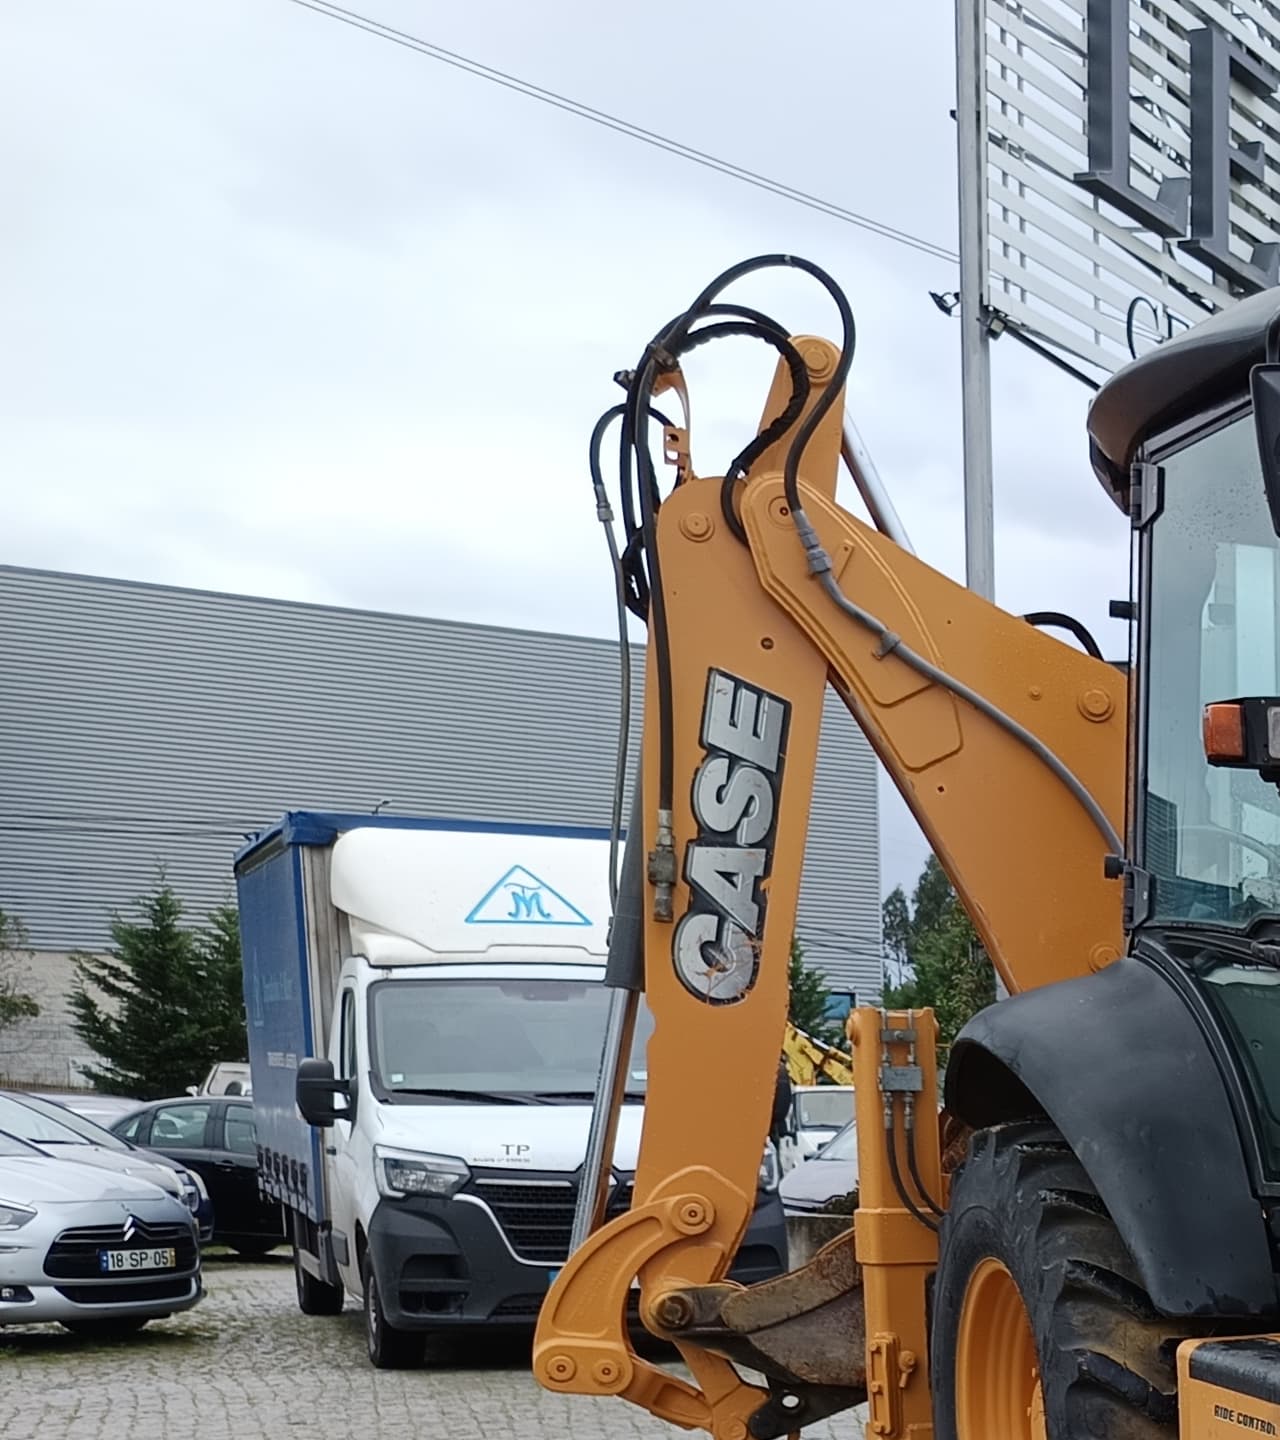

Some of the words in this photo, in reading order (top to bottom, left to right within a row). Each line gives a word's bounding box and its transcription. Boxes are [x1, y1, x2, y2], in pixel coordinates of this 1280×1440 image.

[672, 667, 791, 1005] CASE
[500, 1144, 530, 1156] TP
[1214, 1404, 1235, 1422] RIDE
[1236, 1412, 1279, 1437] CONTROL
